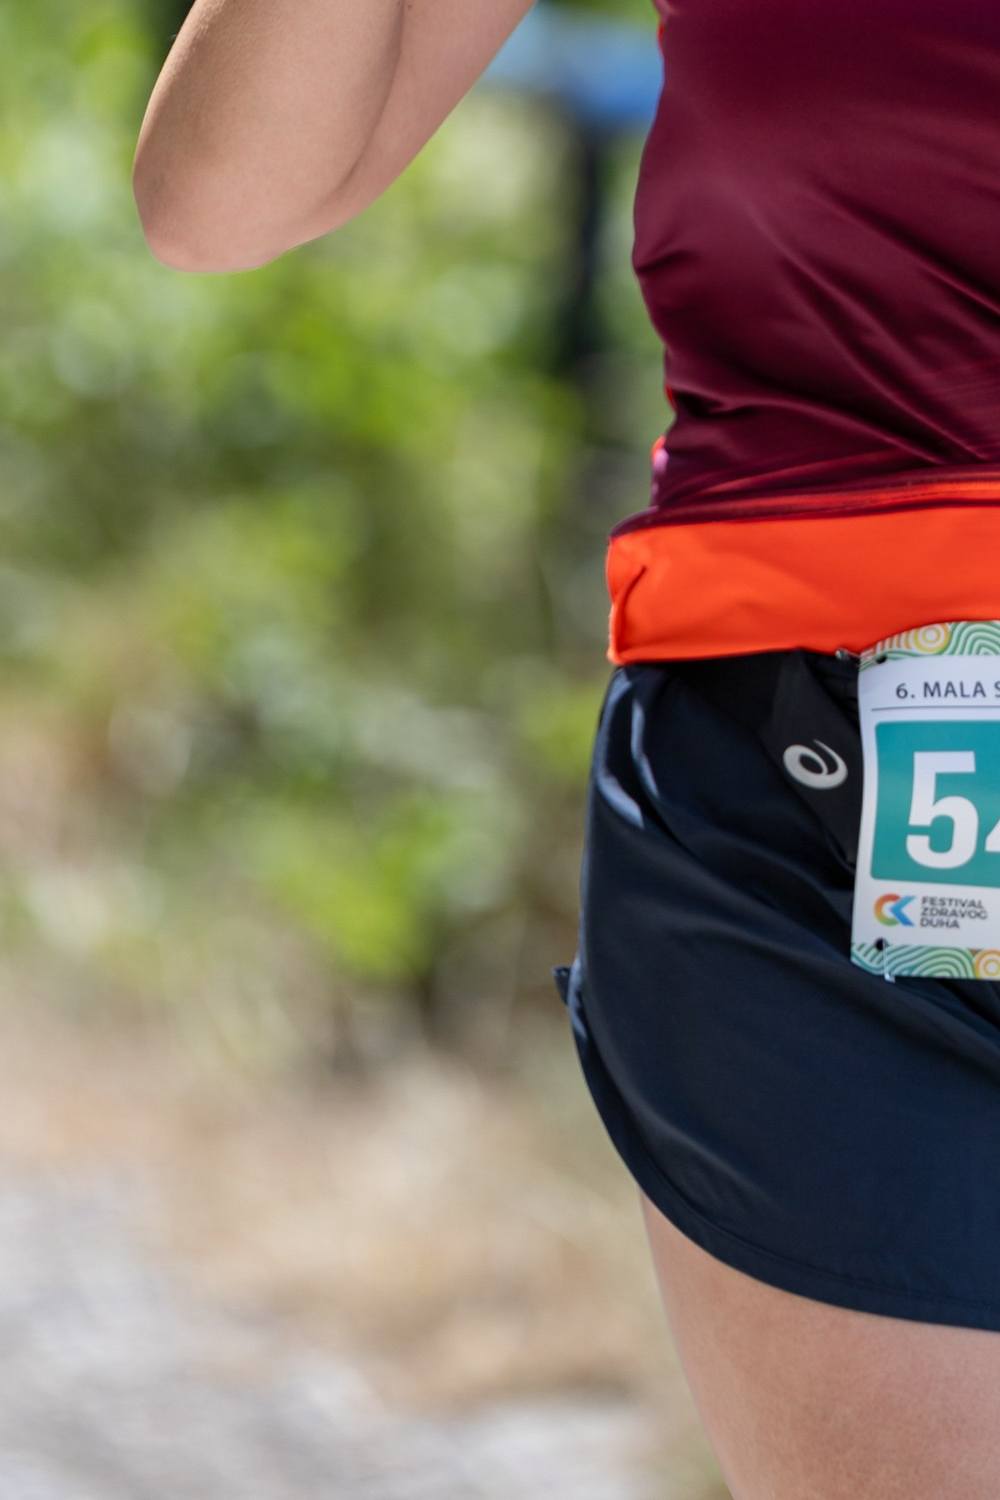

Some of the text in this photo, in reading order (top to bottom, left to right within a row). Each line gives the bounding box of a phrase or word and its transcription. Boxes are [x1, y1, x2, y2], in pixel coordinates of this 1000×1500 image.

[896, 681, 915, 699] 6.
[923, 680, 986, 699] MALA
[921, 896, 985, 909] FESTIVAL
[920, 906, 988, 920] ZDRAVOG
[919, 917, 961, 930] DUHA
